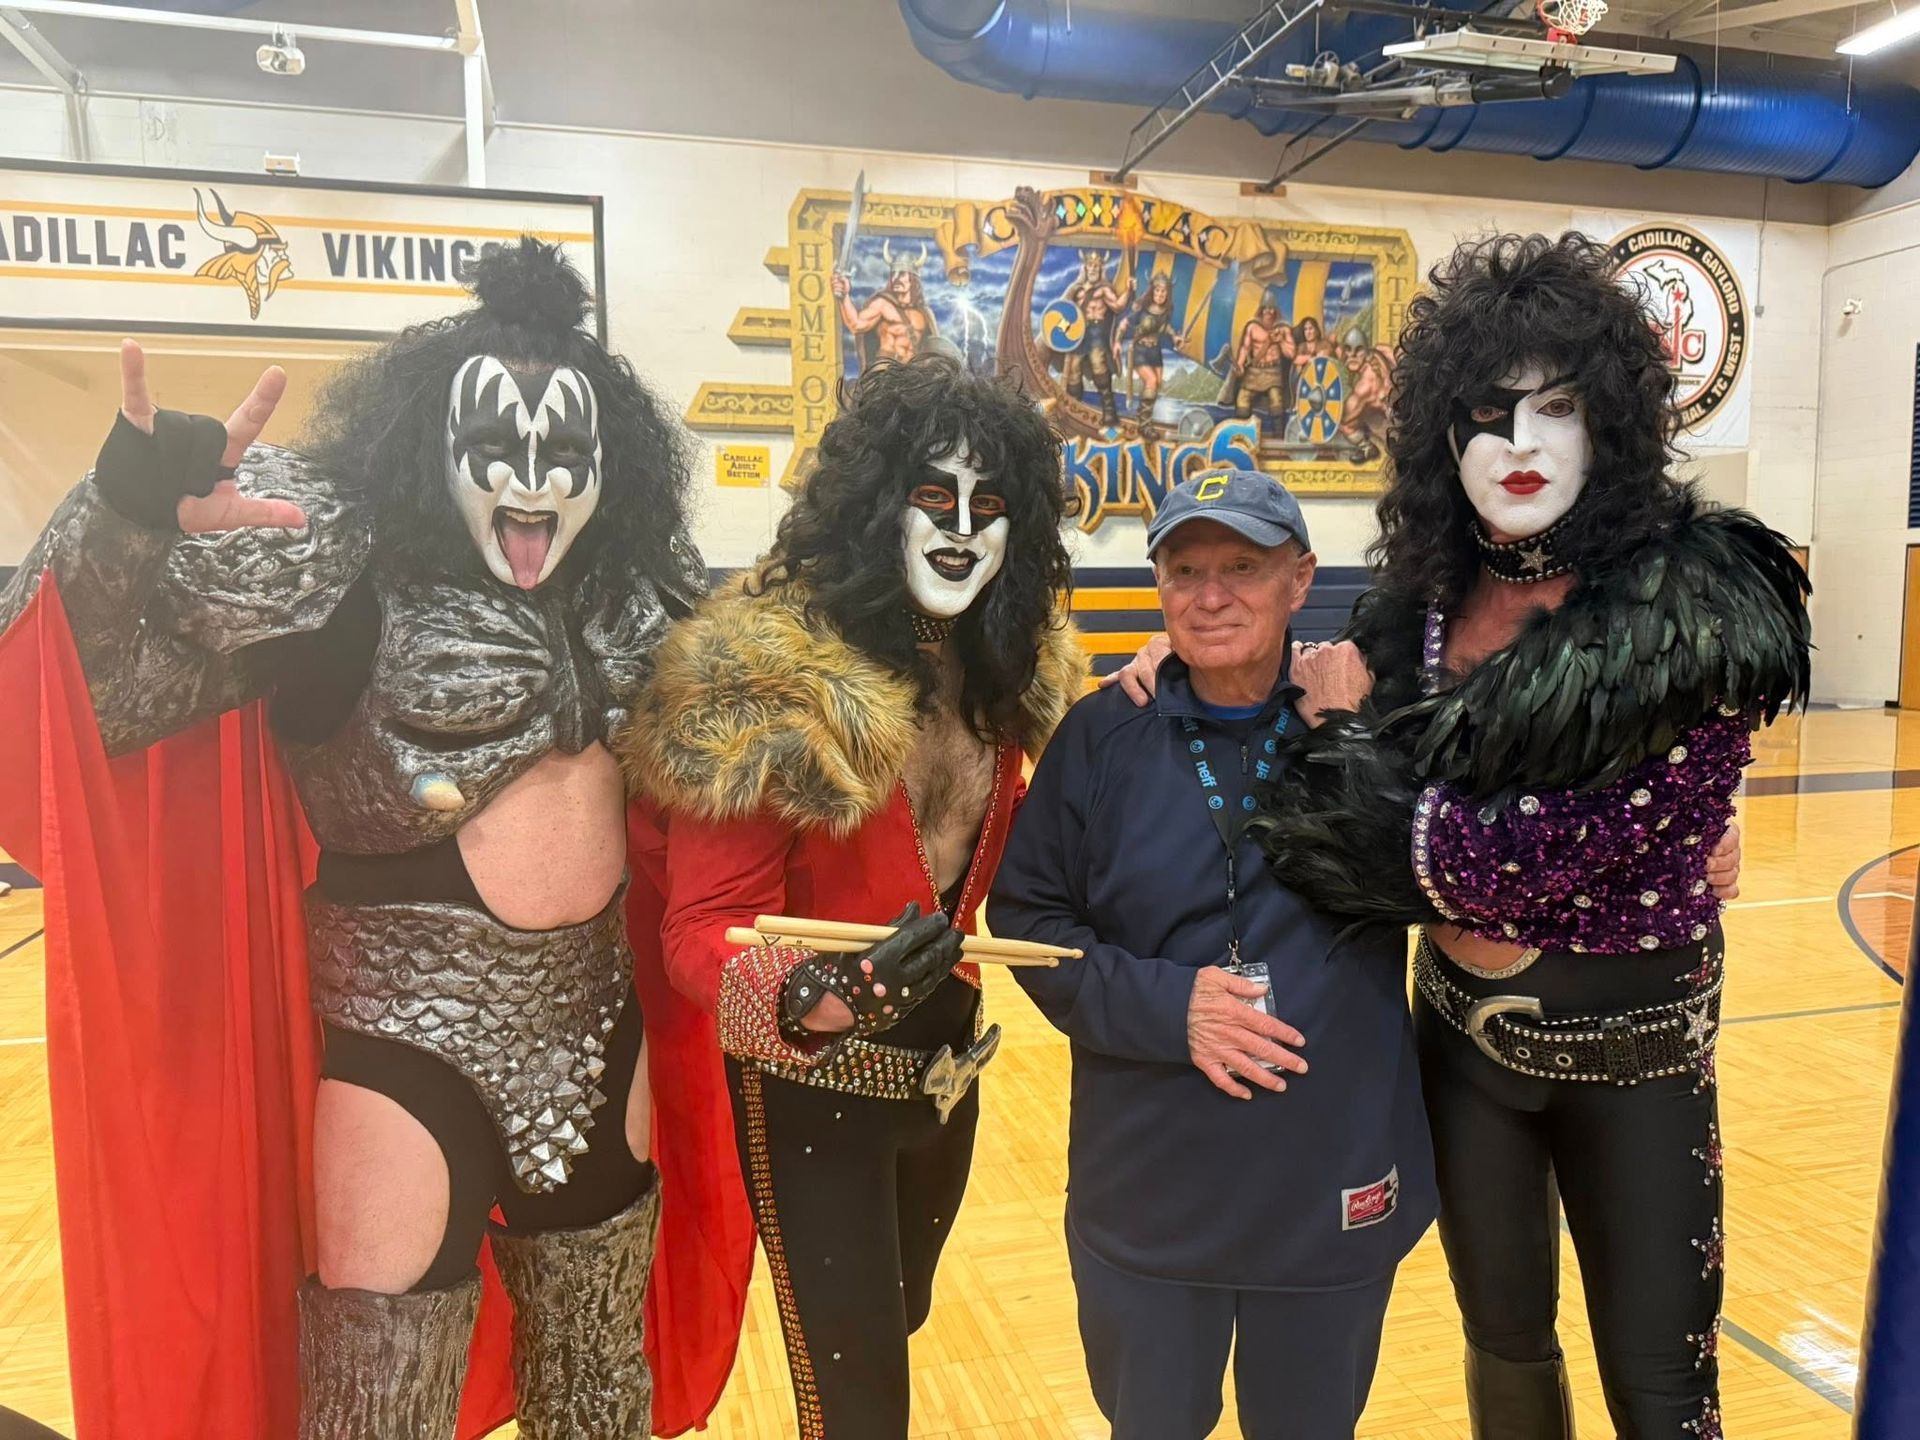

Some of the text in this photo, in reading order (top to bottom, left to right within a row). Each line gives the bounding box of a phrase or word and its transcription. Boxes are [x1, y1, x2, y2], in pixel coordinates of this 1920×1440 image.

[983, 192, 1229, 259] CDILLAC
[1628, 231, 1692, 252] CADILLAC
[322, 232, 500, 284] VIKING
[1702, 250, 1740, 314] GAYLORD
[798, 243, 828, 433] HOME OF
[1711, 333, 1742, 397] TC WEST
[1062, 419, 1260, 531] KINGS
[1196, 475, 1229, 501] C
[1182, 716, 1199, 732] eff
[1195, 760, 1217, 787] neff
[1256, 760, 1270, 780] eff
